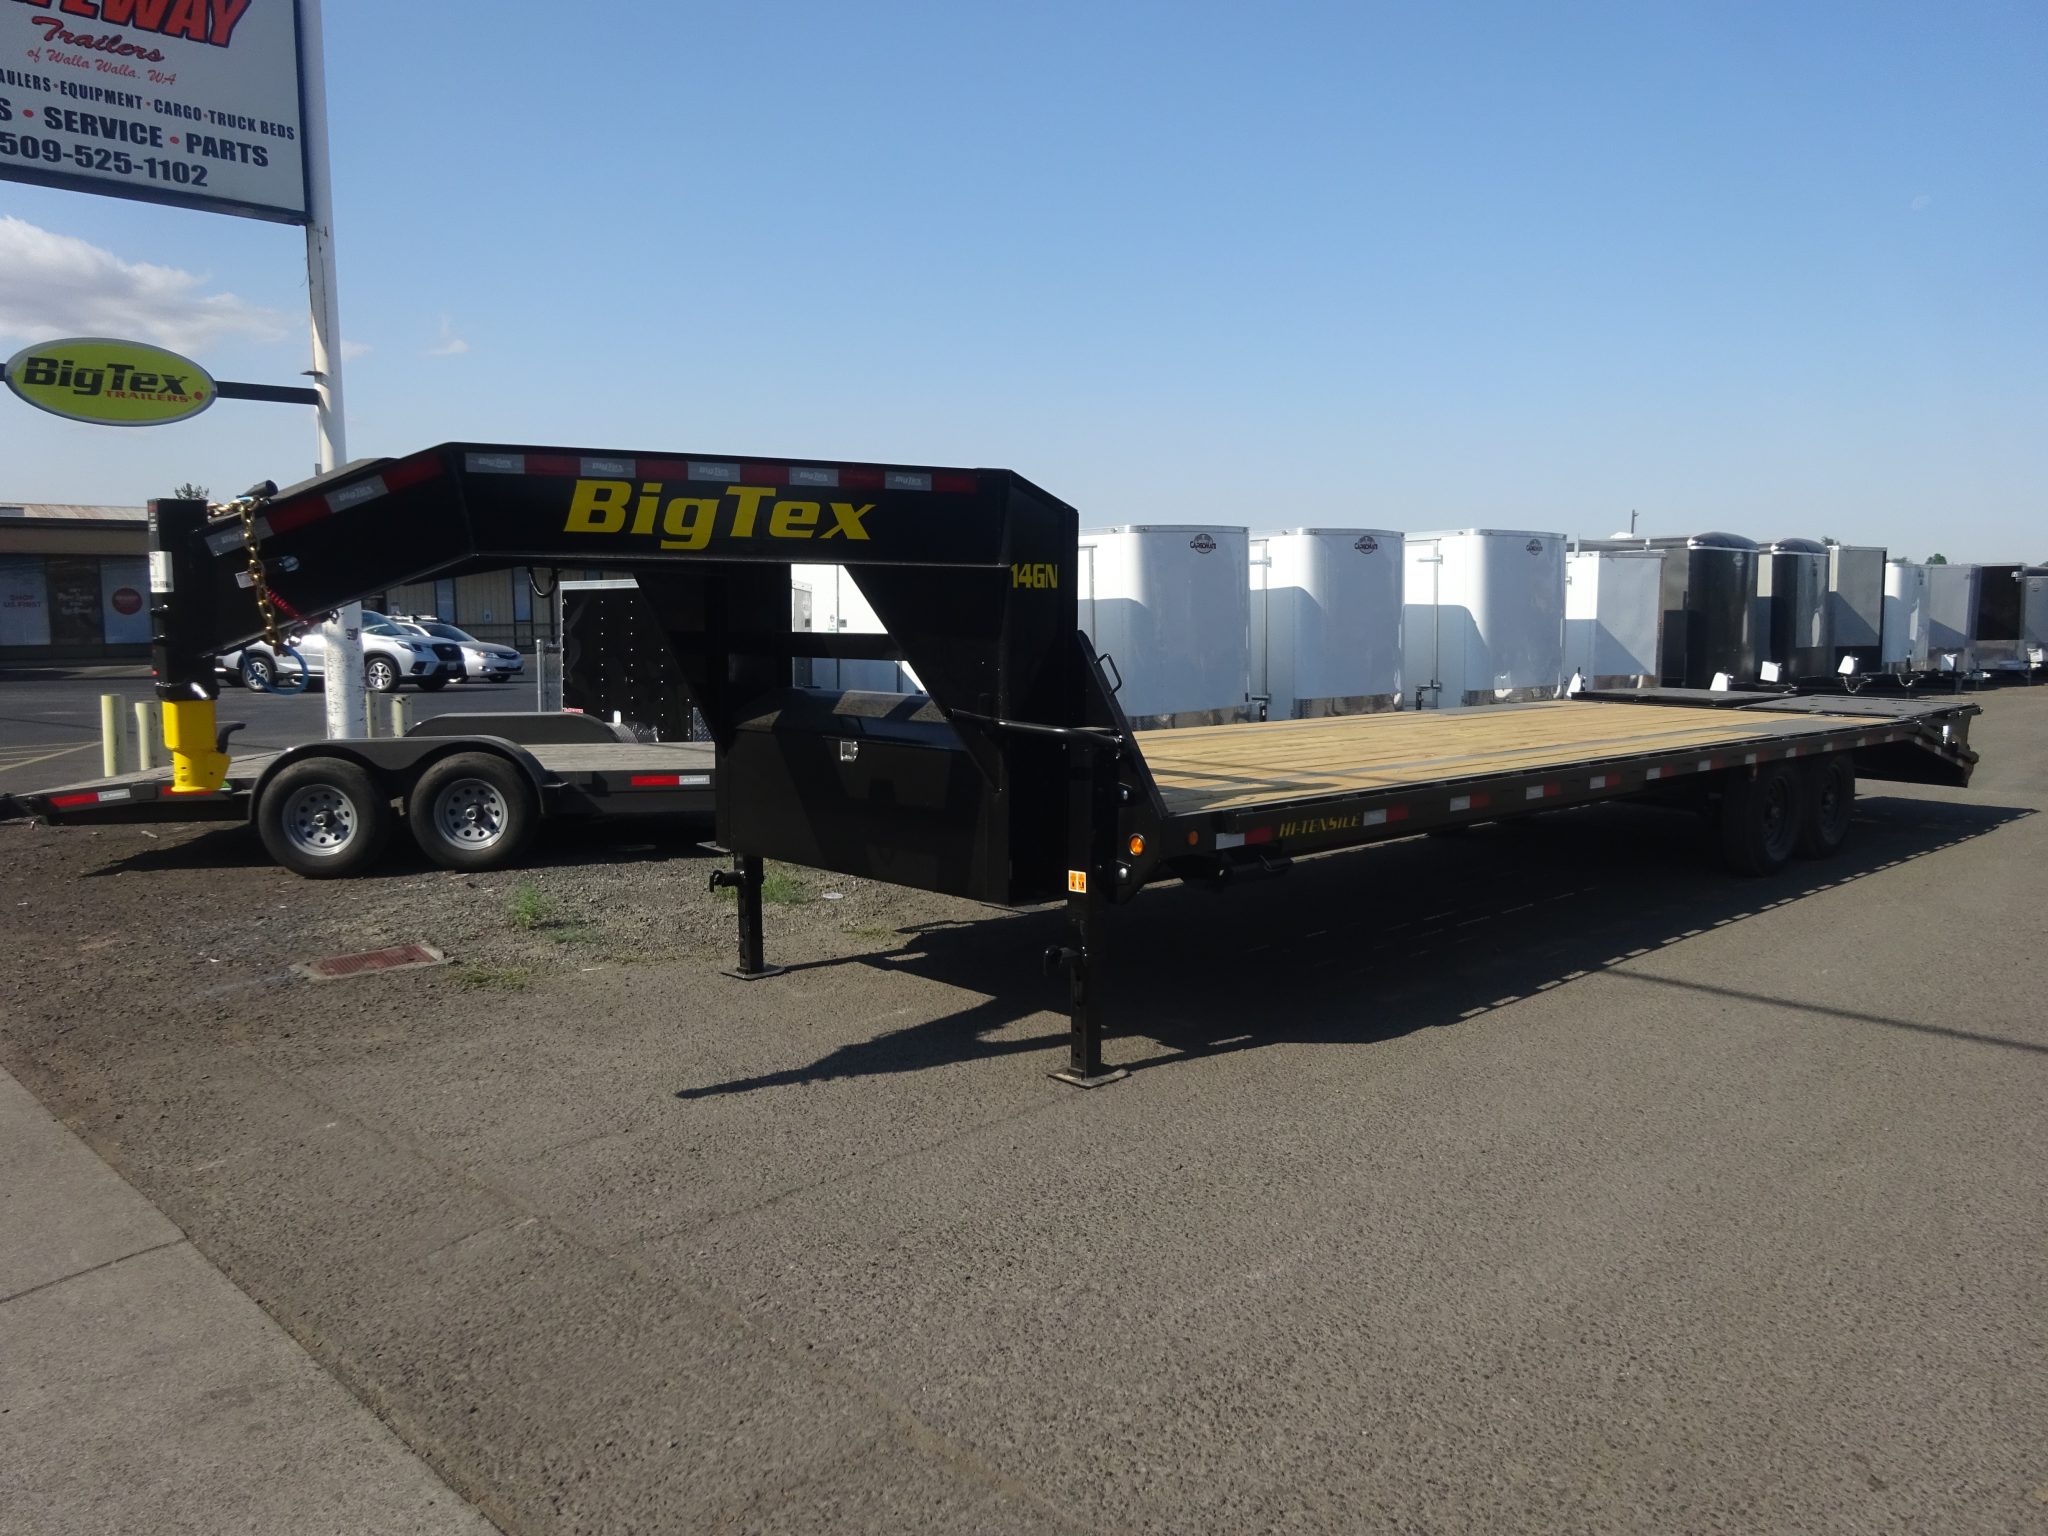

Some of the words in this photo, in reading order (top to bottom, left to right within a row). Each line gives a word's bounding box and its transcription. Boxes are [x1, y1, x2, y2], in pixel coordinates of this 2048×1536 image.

[31, 15, 165, 62] Trailers
[26, 46, 42, 63] of
[46, 48, 90, 69] Walla
[147, 69, 177, 85] WA
[60, 81, 143, 110] EQUIPMENT
[154, 99, 202, 121] CARGO
[207, 109, 257, 133] TRUCK
[260, 122, 295, 140] BEDS
[44, 106, 163, 149] SERVICE
[186, 132, 269, 168] PARTS
[0, 131, 208, 187] 509-525-1102
[23, 357, 188, 396] BigTex
[105, 390, 188, 402] TRAILERS
[564, 479, 877, 550] BigTex
[1011, 563, 1058, 589] 14GN
[1278, 816, 1360, 837] HI-TENSILE
